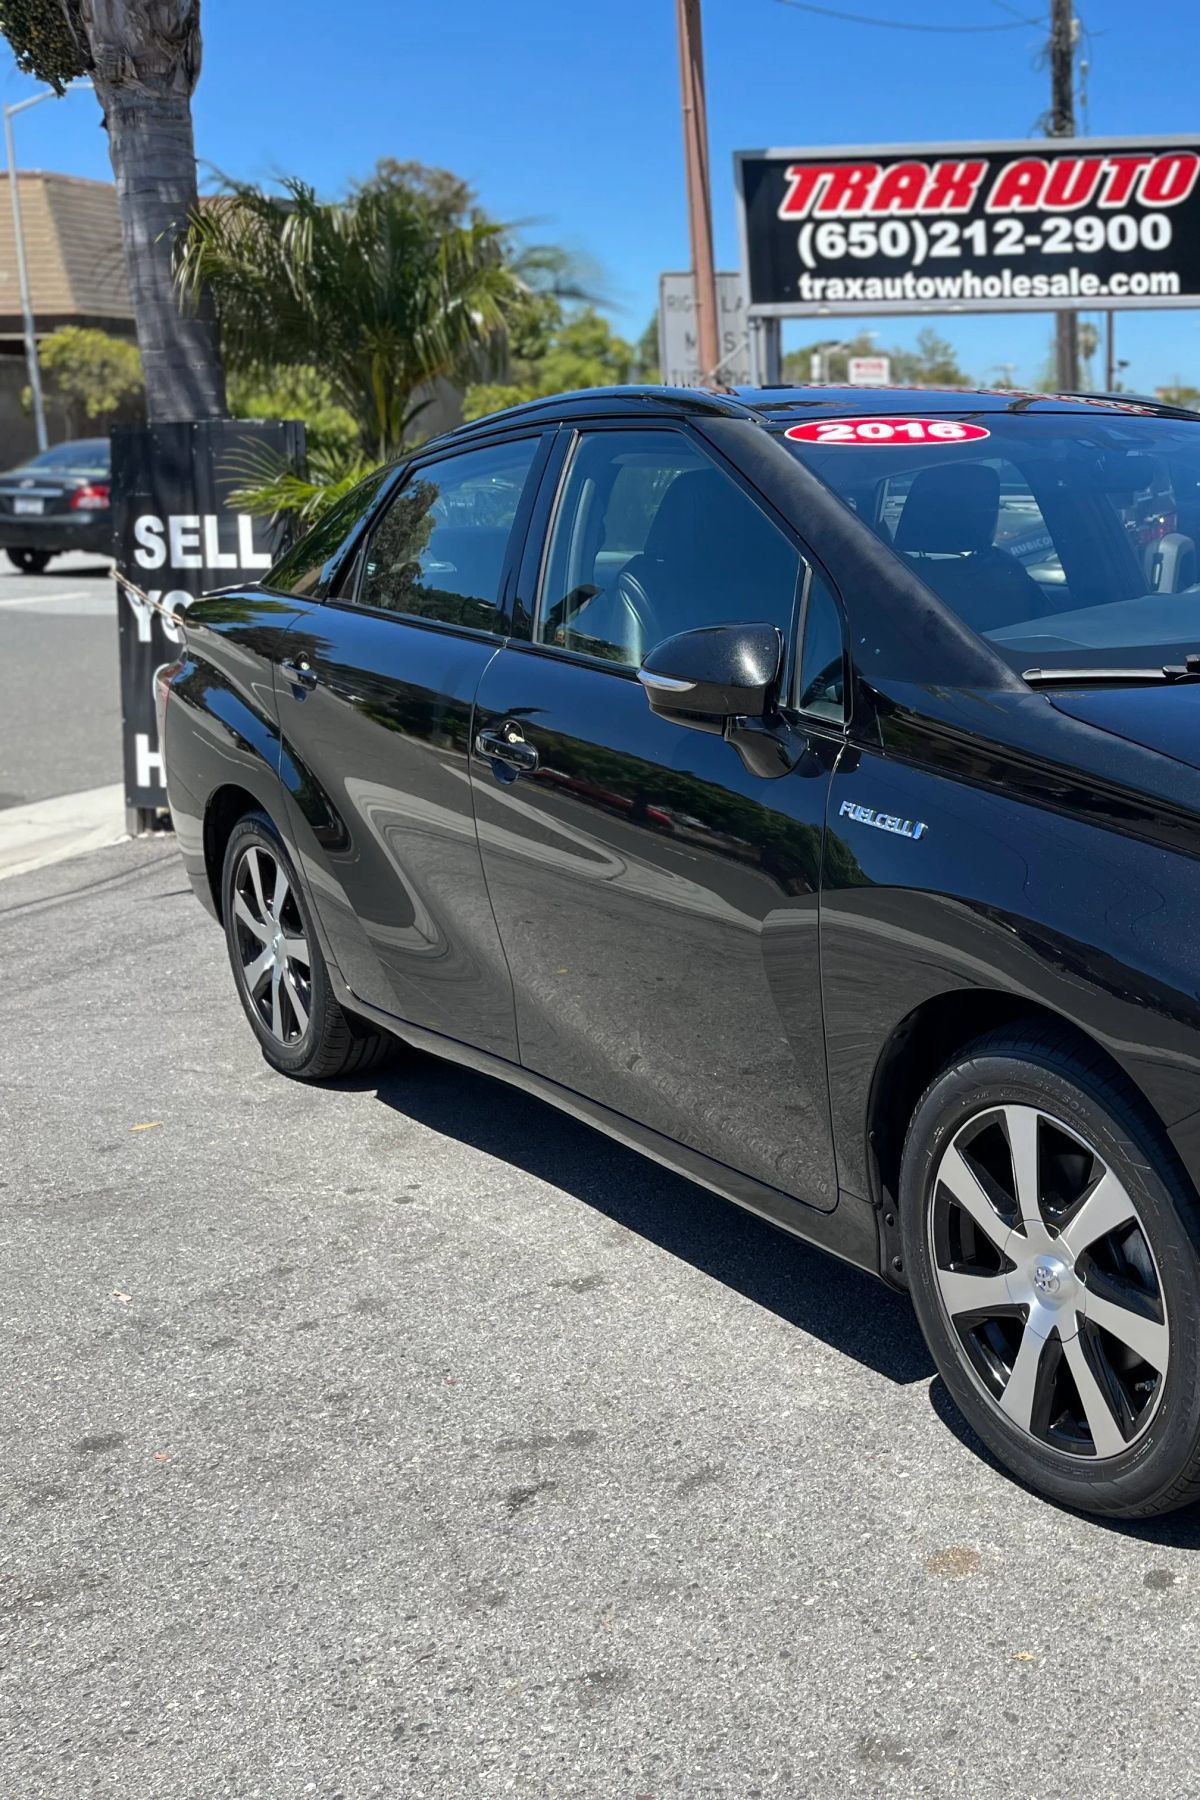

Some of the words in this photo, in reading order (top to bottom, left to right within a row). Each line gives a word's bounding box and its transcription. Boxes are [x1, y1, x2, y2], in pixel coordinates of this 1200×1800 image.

[778, 158, 990, 219] TRAX
[798, 214, 1172, 269] (650)212-2900
[799, 267, 1180, 302] traxautowholesale.com
[816, 422, 967, 441] 2016
[134, 514, 272, 569] SELL
[125, 590, 205, 643] YO
